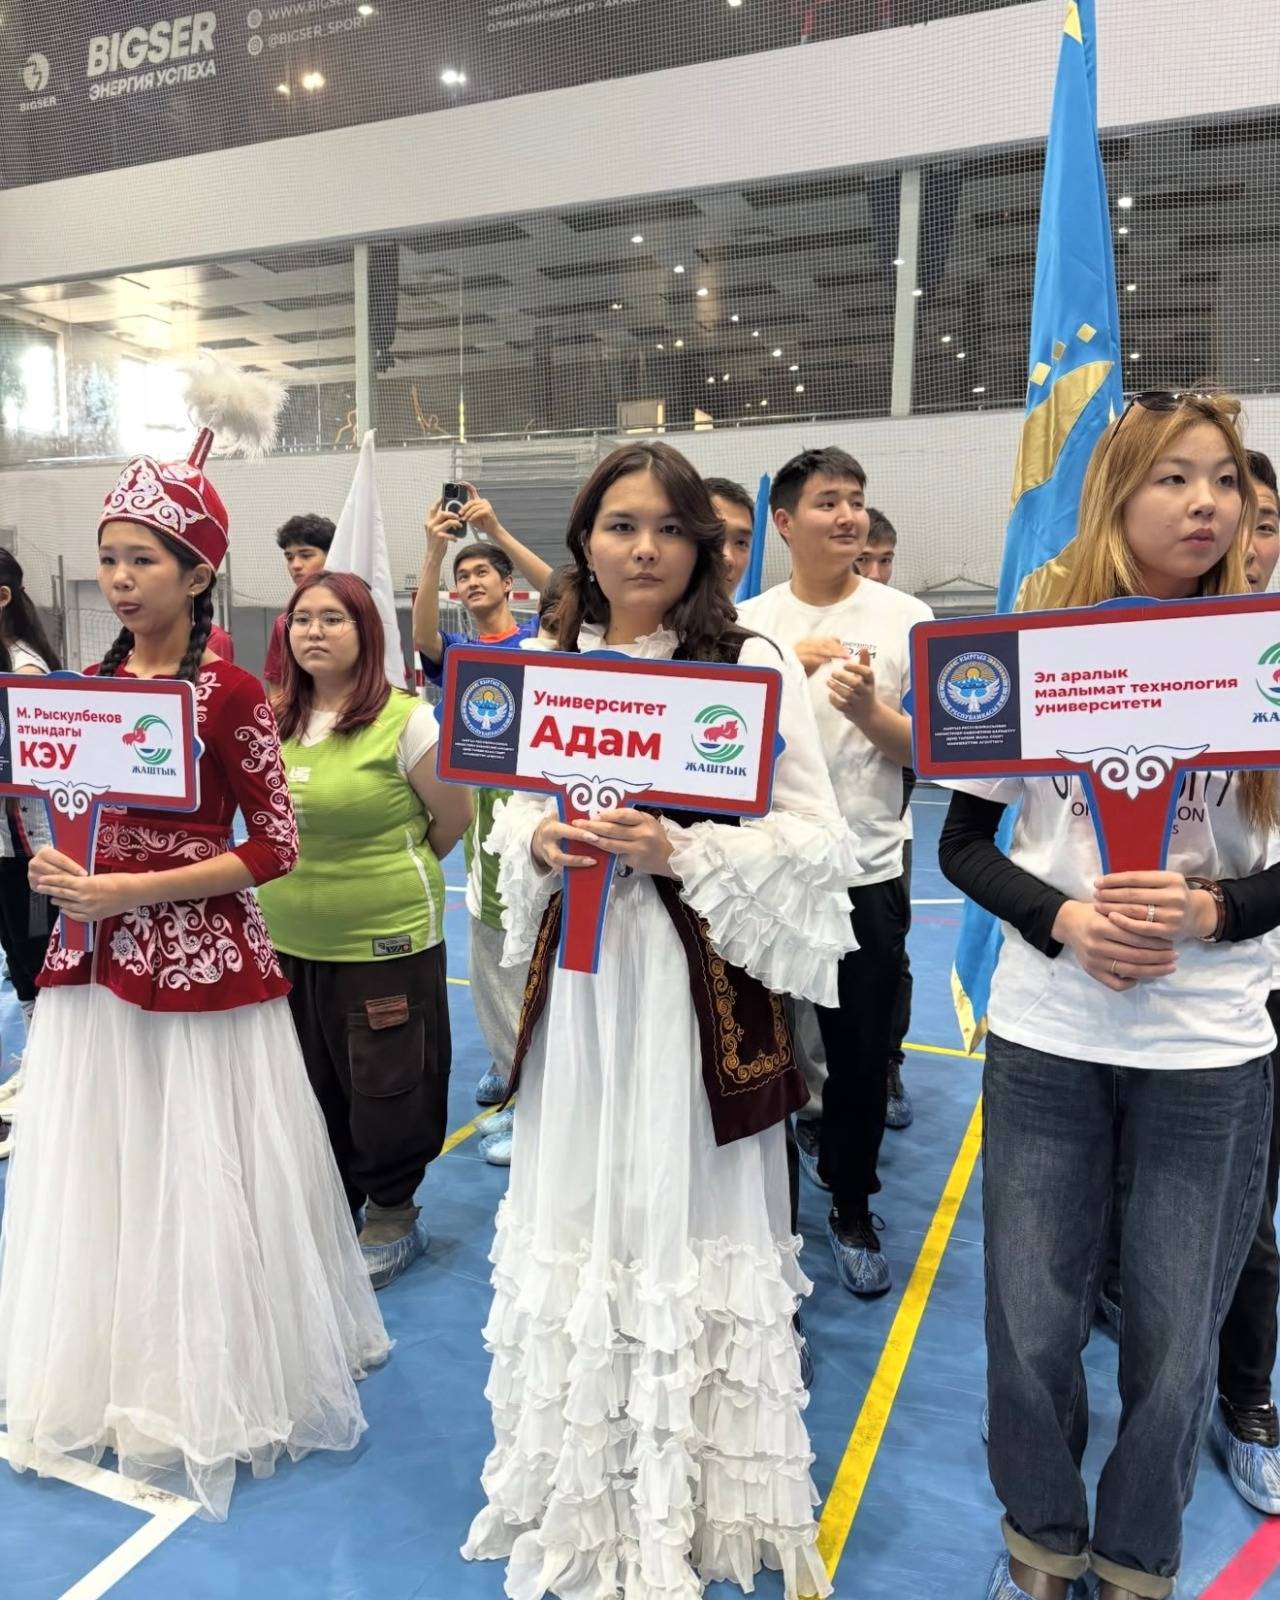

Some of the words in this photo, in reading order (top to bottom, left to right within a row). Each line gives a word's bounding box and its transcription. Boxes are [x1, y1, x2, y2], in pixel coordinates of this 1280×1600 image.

[87, 11, 217, 77] BIGSER
[89, 72, 155, 101] ЭНЕРГИЯ
[156, 59, 217, 87] УСПЕХА
[20, 96, 57, 112] BIGSER
[1034, 672, 1056, 684] Эл
[1060, 667, 1128, 684] аралык
[1034, 682, 1125, 699] маалымат
[1131, 677, 1239, 694] технология
[533, 690, 667, 717] Университет
[1034, 697, 1163, 717] университети
[16, 707, 31, 719] М.
[34, 708, 122, 724] Рыскулбеков
[17, 724, 82, 738] атындагы
[529, 715, 662, 761] Адам
[20, 741, 77, 770] КЭУ
[132, 765, 177, 776] ЖАШТЫК
[684, 761, 748, 777] ЖАШТЫК
